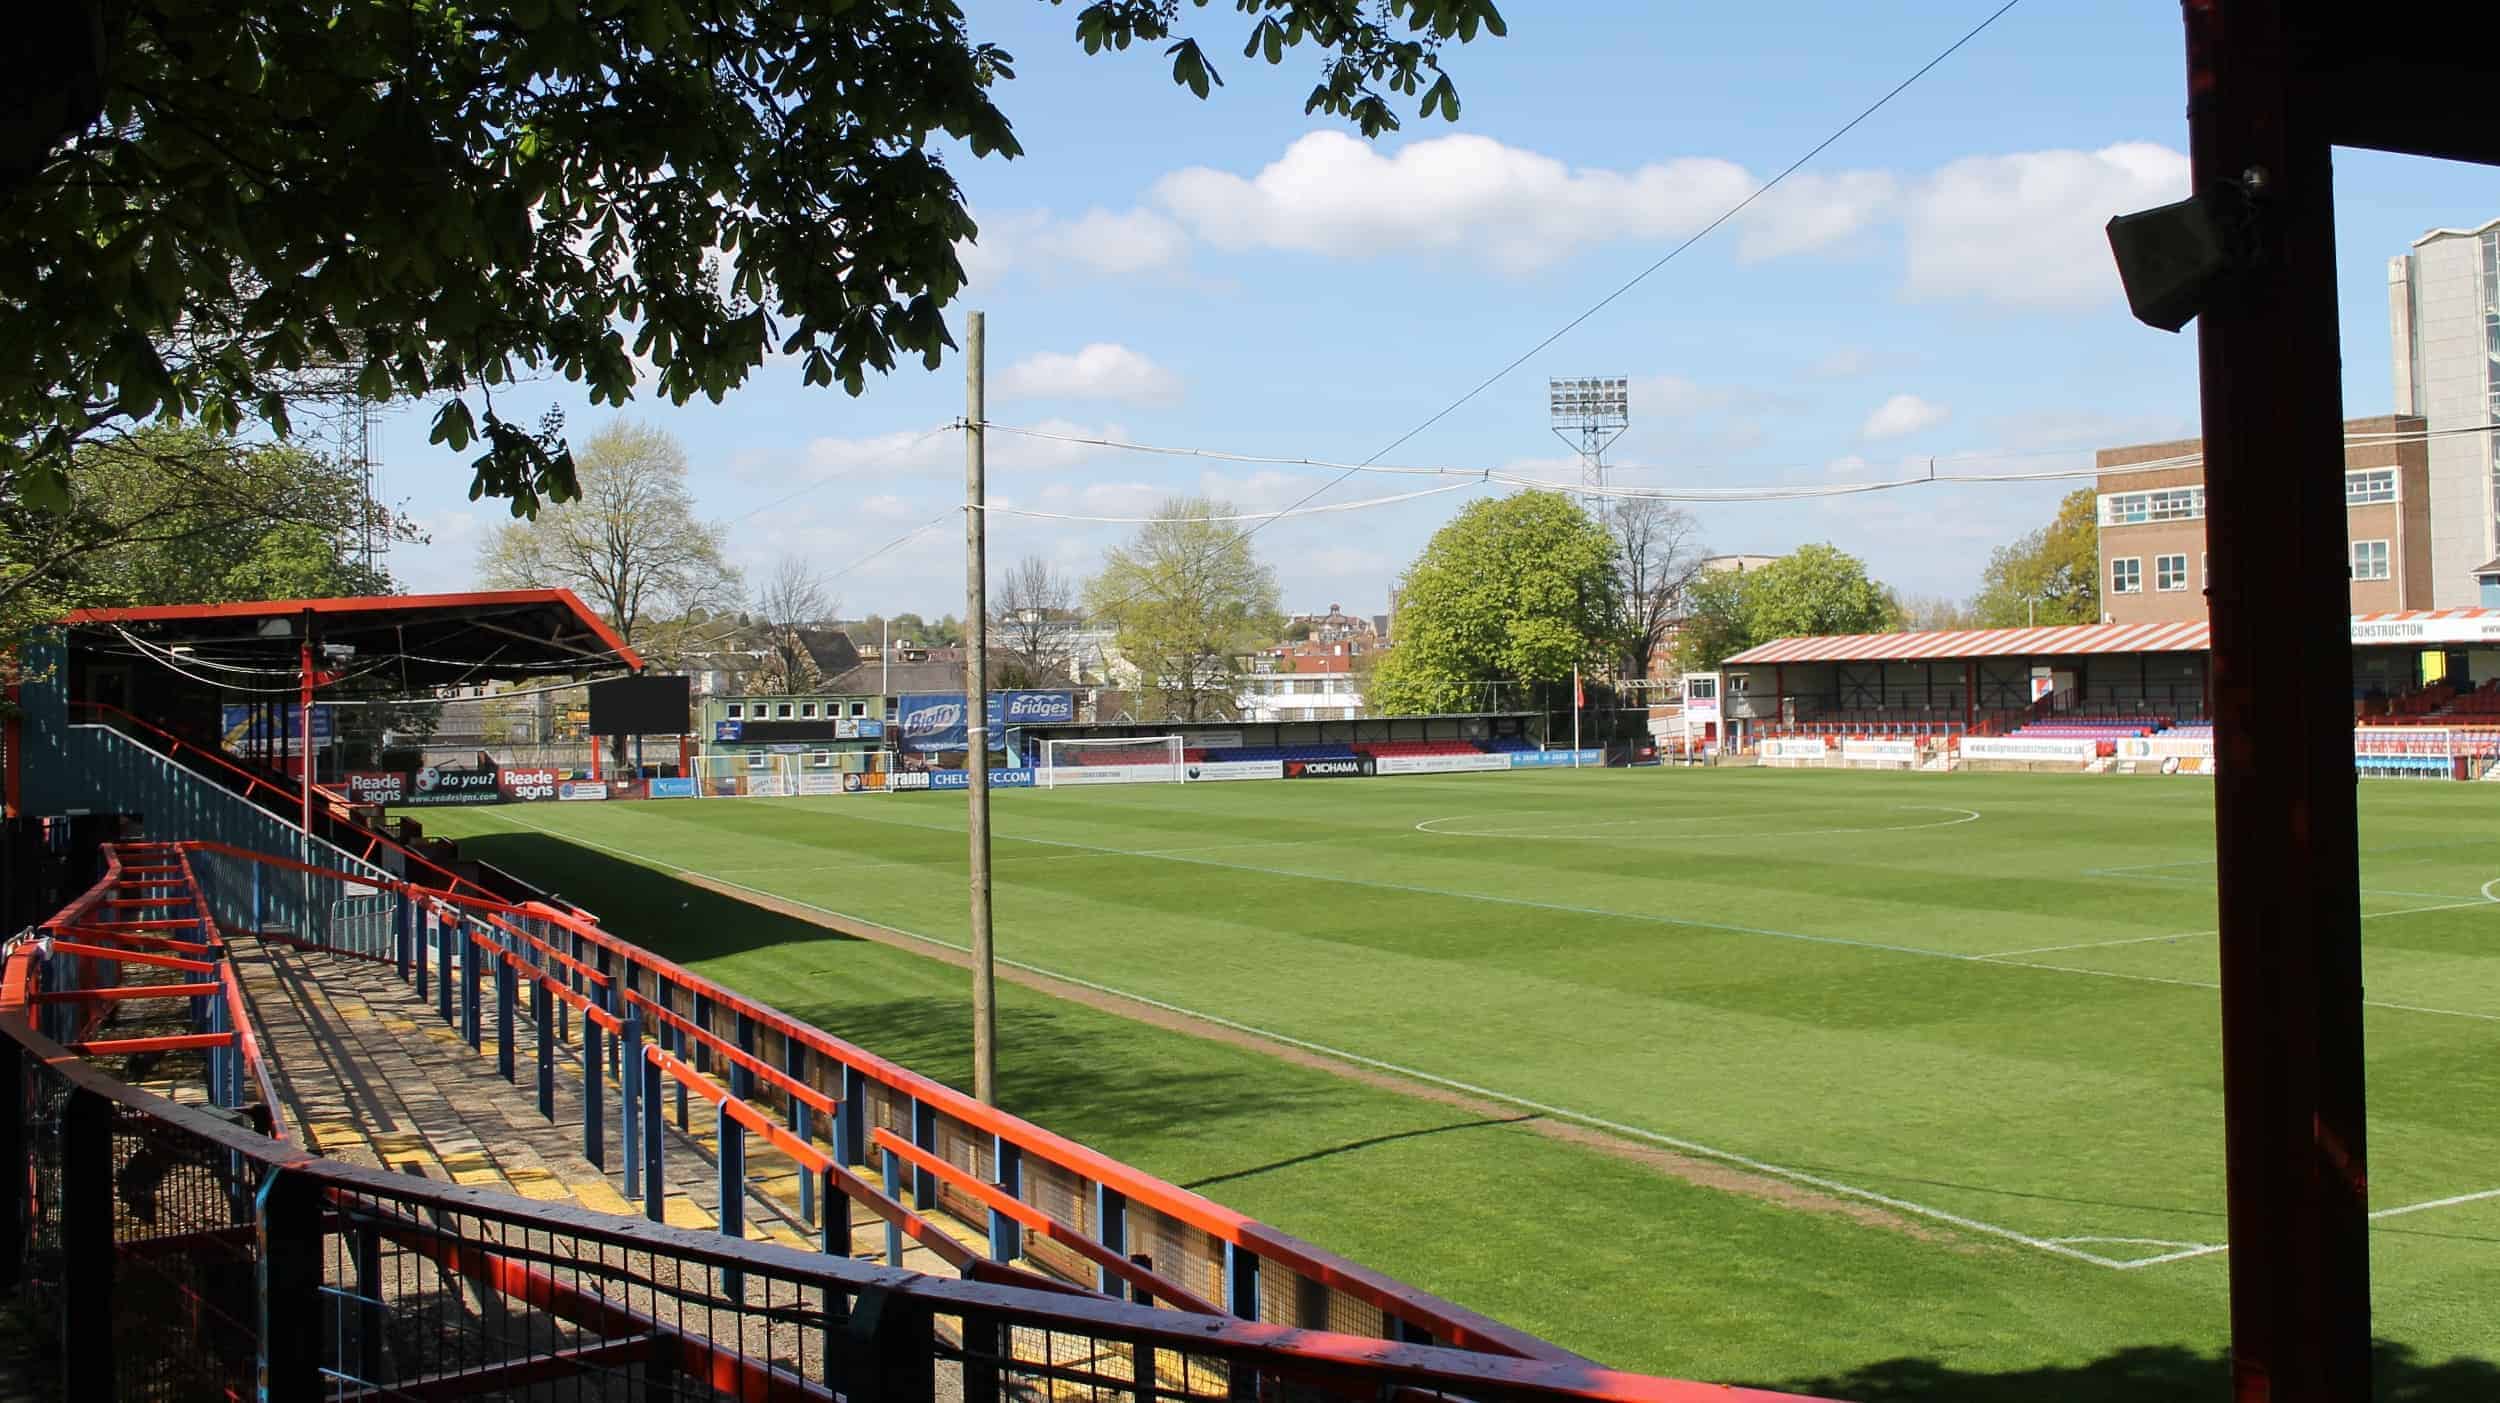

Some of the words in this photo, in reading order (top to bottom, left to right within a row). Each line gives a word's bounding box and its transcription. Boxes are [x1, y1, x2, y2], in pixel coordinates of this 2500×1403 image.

[2352, 623, 2423, 637] CONSTRUCTION
[1010, 700, 1068, 717] Bridges
[1304, 760, 1359, 774] YOKOHAMA
[352, 774, 400, 790] Reade
[441, 774, 458, 786] do
[461, 773, 496, 787] you?
[504, 770, 553, 785] Reade
[935, 772, 1030, 785] CHELFC.COM
[363, 789, 400, 803] signs
[516, 784, 554, 799] signs
